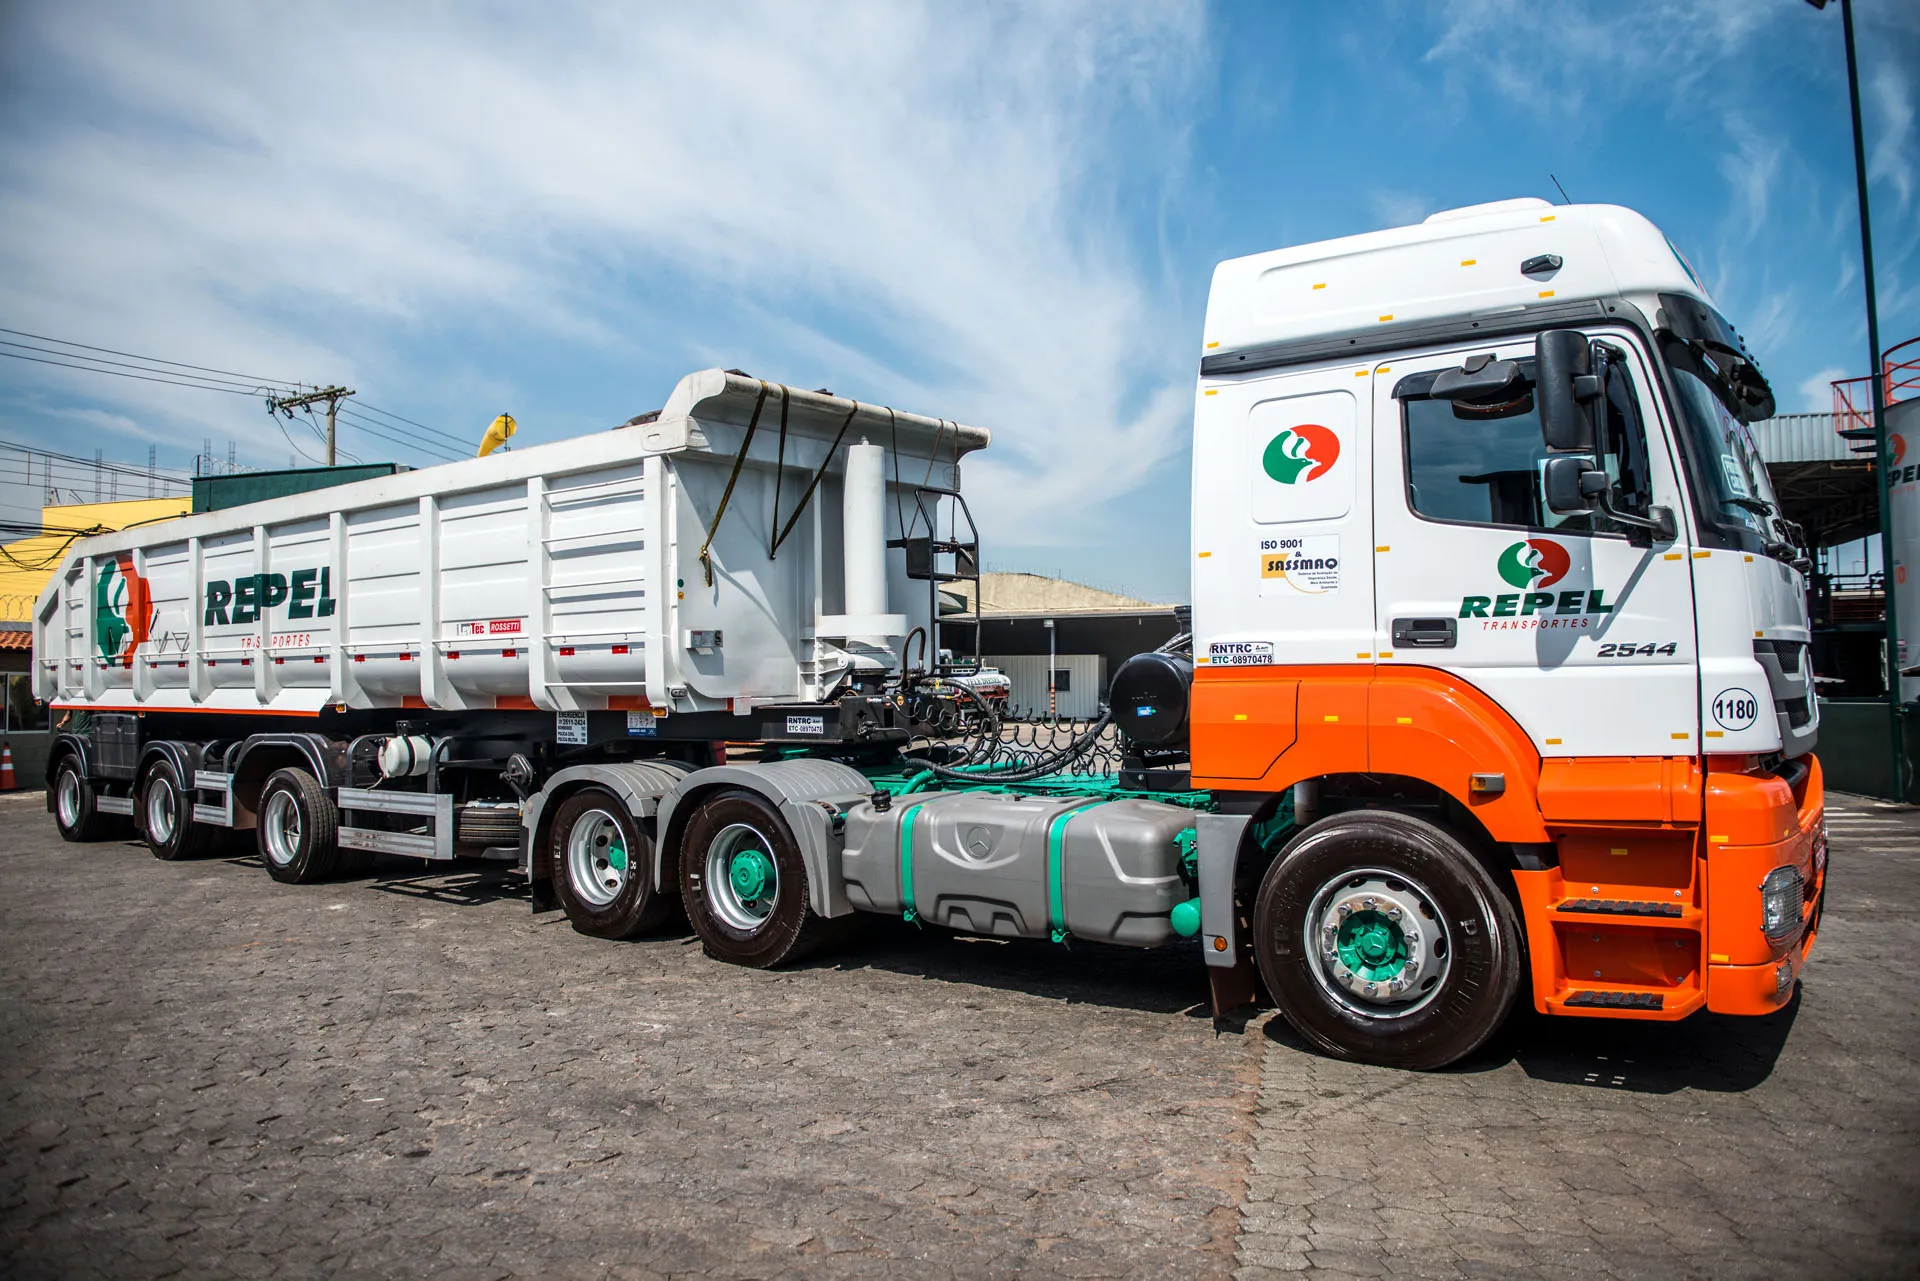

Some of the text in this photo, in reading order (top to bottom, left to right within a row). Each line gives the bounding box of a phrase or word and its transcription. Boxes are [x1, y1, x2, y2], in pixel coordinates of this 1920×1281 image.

[1261, 539, 1303, 550] ISO 9001
[1268, 558, 1338, 572] SASSMAQ
[204, 566, 336, 626] REPEL
[1458, 589, 1615, 619] REPEL
[490, 621, 520, 632] ROSSETTI
[1483, 618, 1589, 631] TRANSPORTES
[241, 634, 311, 649] TRSPORTES
[1211, 643, 1252, 654] RNTRC
[1597, 641, 1678, 658] 2544
[1211, 655, 1273, 665] ETC-08970478
[1715, 699, 1755, 719] 1180
[788, 717, 811, 725] RNTRC
